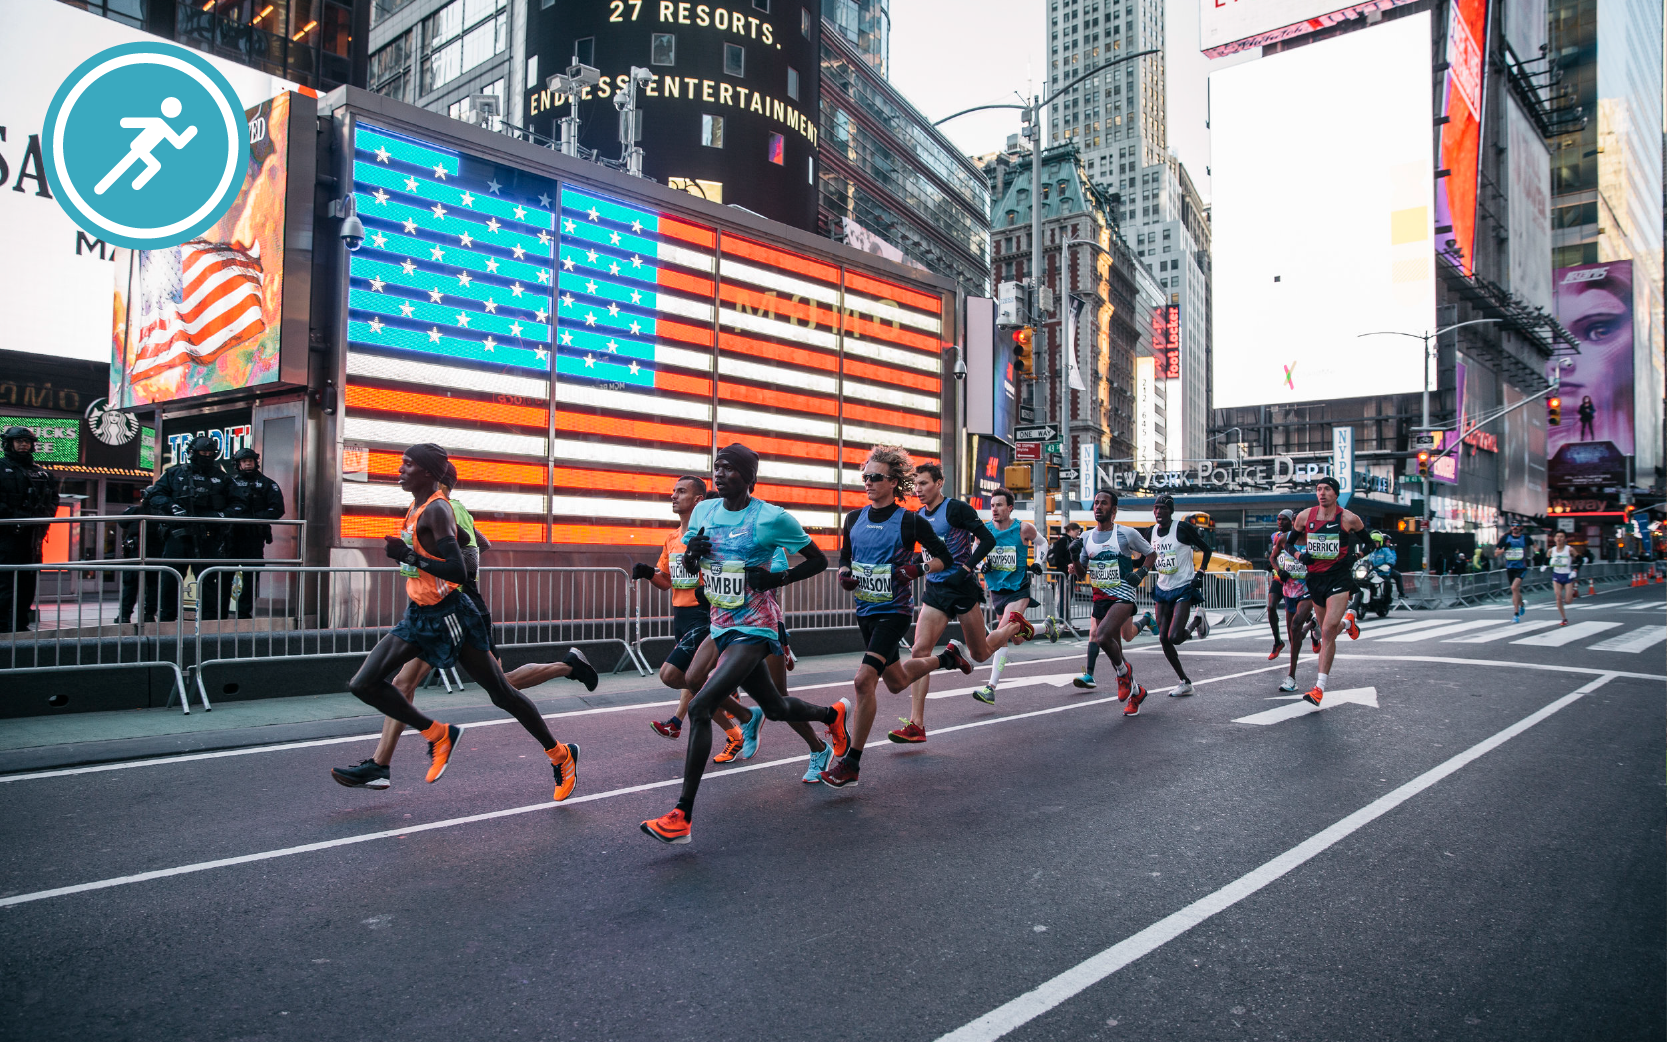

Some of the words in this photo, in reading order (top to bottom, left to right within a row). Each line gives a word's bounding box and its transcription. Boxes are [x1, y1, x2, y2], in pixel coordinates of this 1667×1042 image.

[609, 0, 642, 22] 27
[659, 1, 782, 50] RESORTS.
[531, 75, 630, 116] ENDESS
[1166, 307, 1179, 349] Locker
[1166, 350, 1179, 378] Foot
[1038, 429, 1052, 437] WAY
[1338, 430, 1347, 490] NYPD
[1308, 541, 1339, 552] DERRICK
